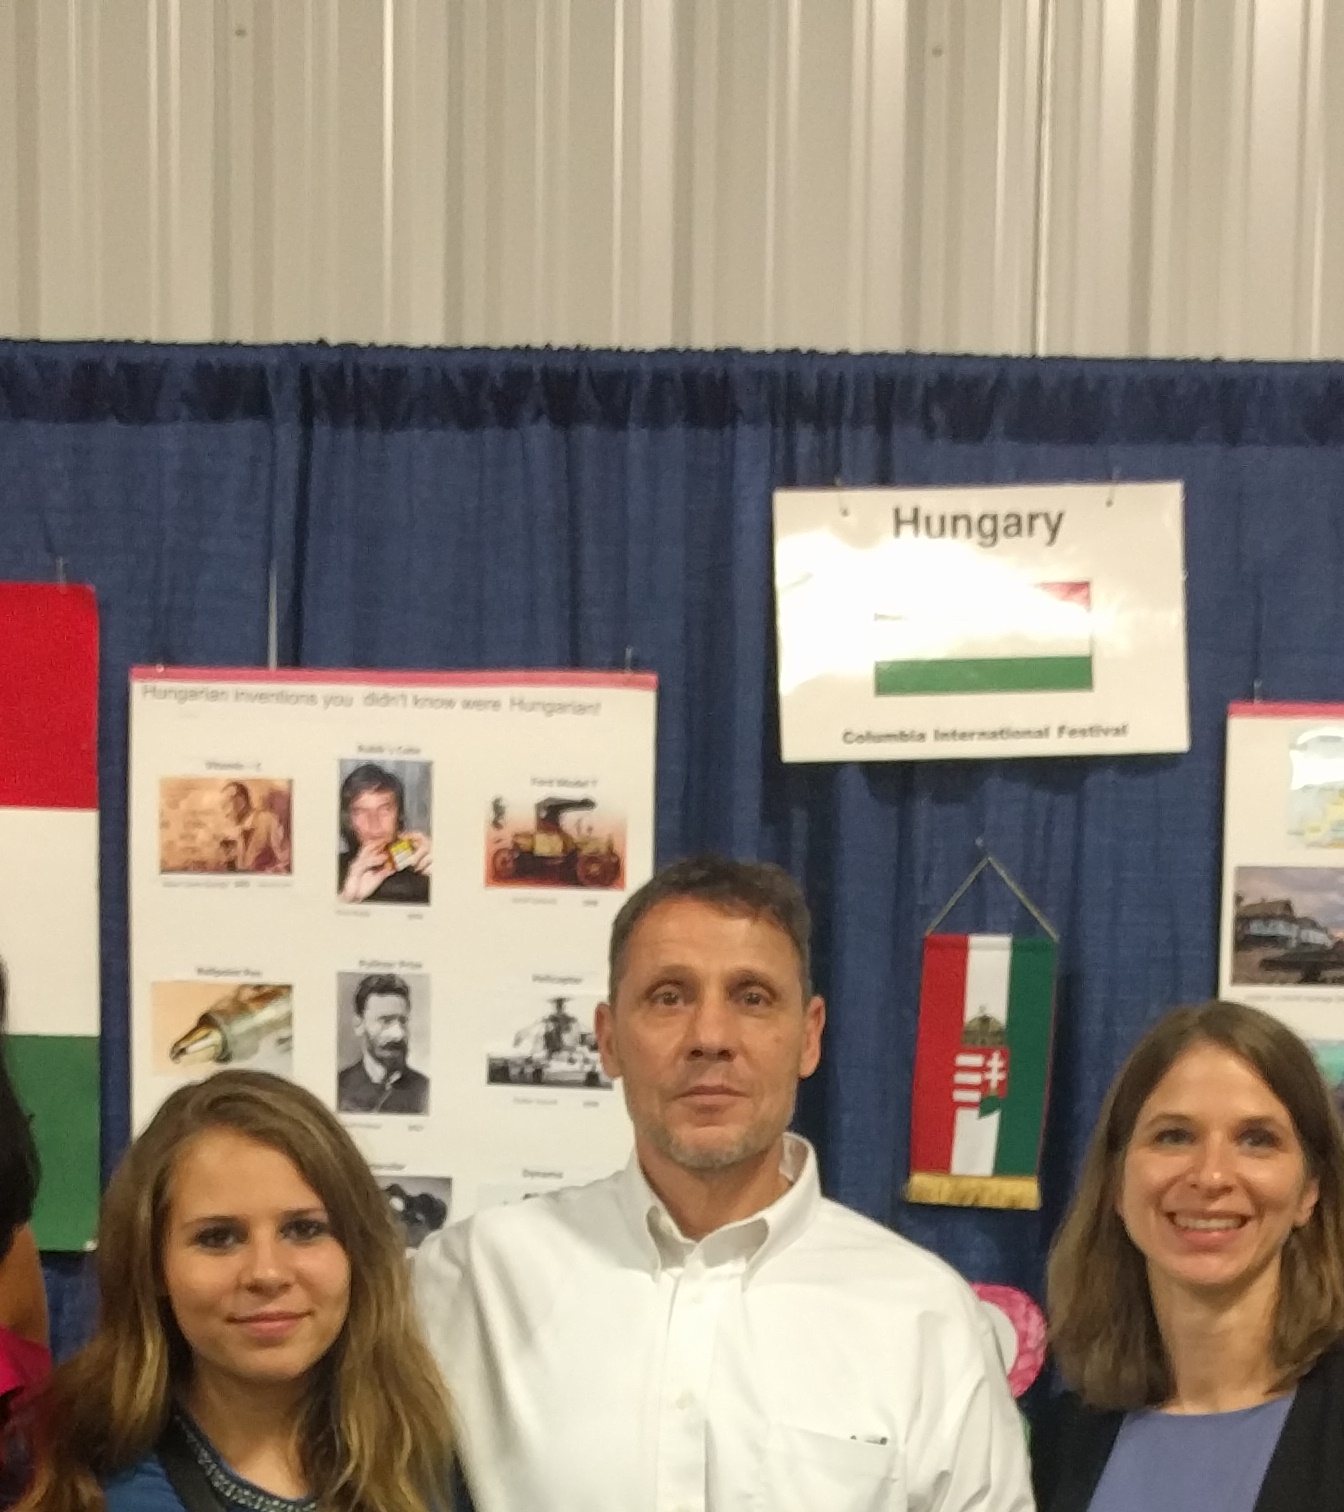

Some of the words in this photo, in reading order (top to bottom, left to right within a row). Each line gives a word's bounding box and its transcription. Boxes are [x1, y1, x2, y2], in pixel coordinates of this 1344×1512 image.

[892, 505, 1065, 548] Hungary
[142, 685, 230, 705] Hungarian
[323, 693, 354, 710] you
[412, 694, 456, 710] know
[842, 730, 927, 745] Columbia
[933, 726, 1050, 742] International
[1057, 723, 1129, 740] Festival
